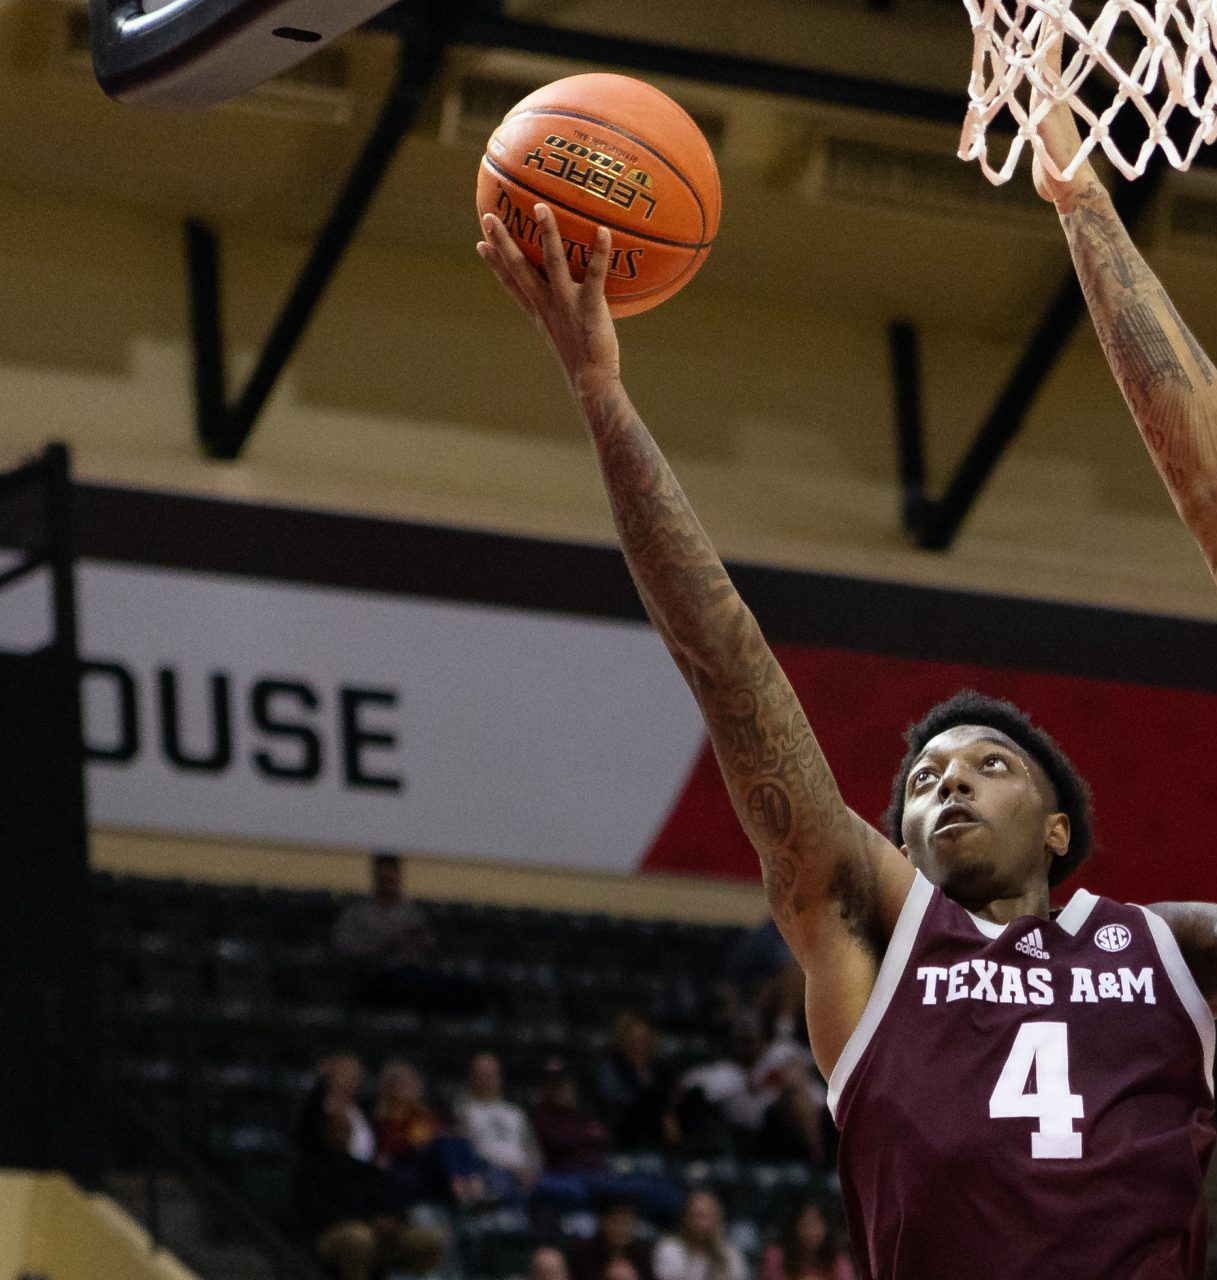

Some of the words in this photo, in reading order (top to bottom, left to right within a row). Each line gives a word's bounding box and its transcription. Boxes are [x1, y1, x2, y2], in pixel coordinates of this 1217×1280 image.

[544, 134, 627, 177] 1000
[522, 147, 657, 221] LEGACY
[80, 656, 405, 796] OUSE
[1015, 941, 1050, 960] adidas
[1097, 926, 1129, 950] SEC
[917, 959, 1054, 1006] TEXAS
[1070, 967, 1157, 1005] A&M
[989, 1021, 1085, 1159] 4
